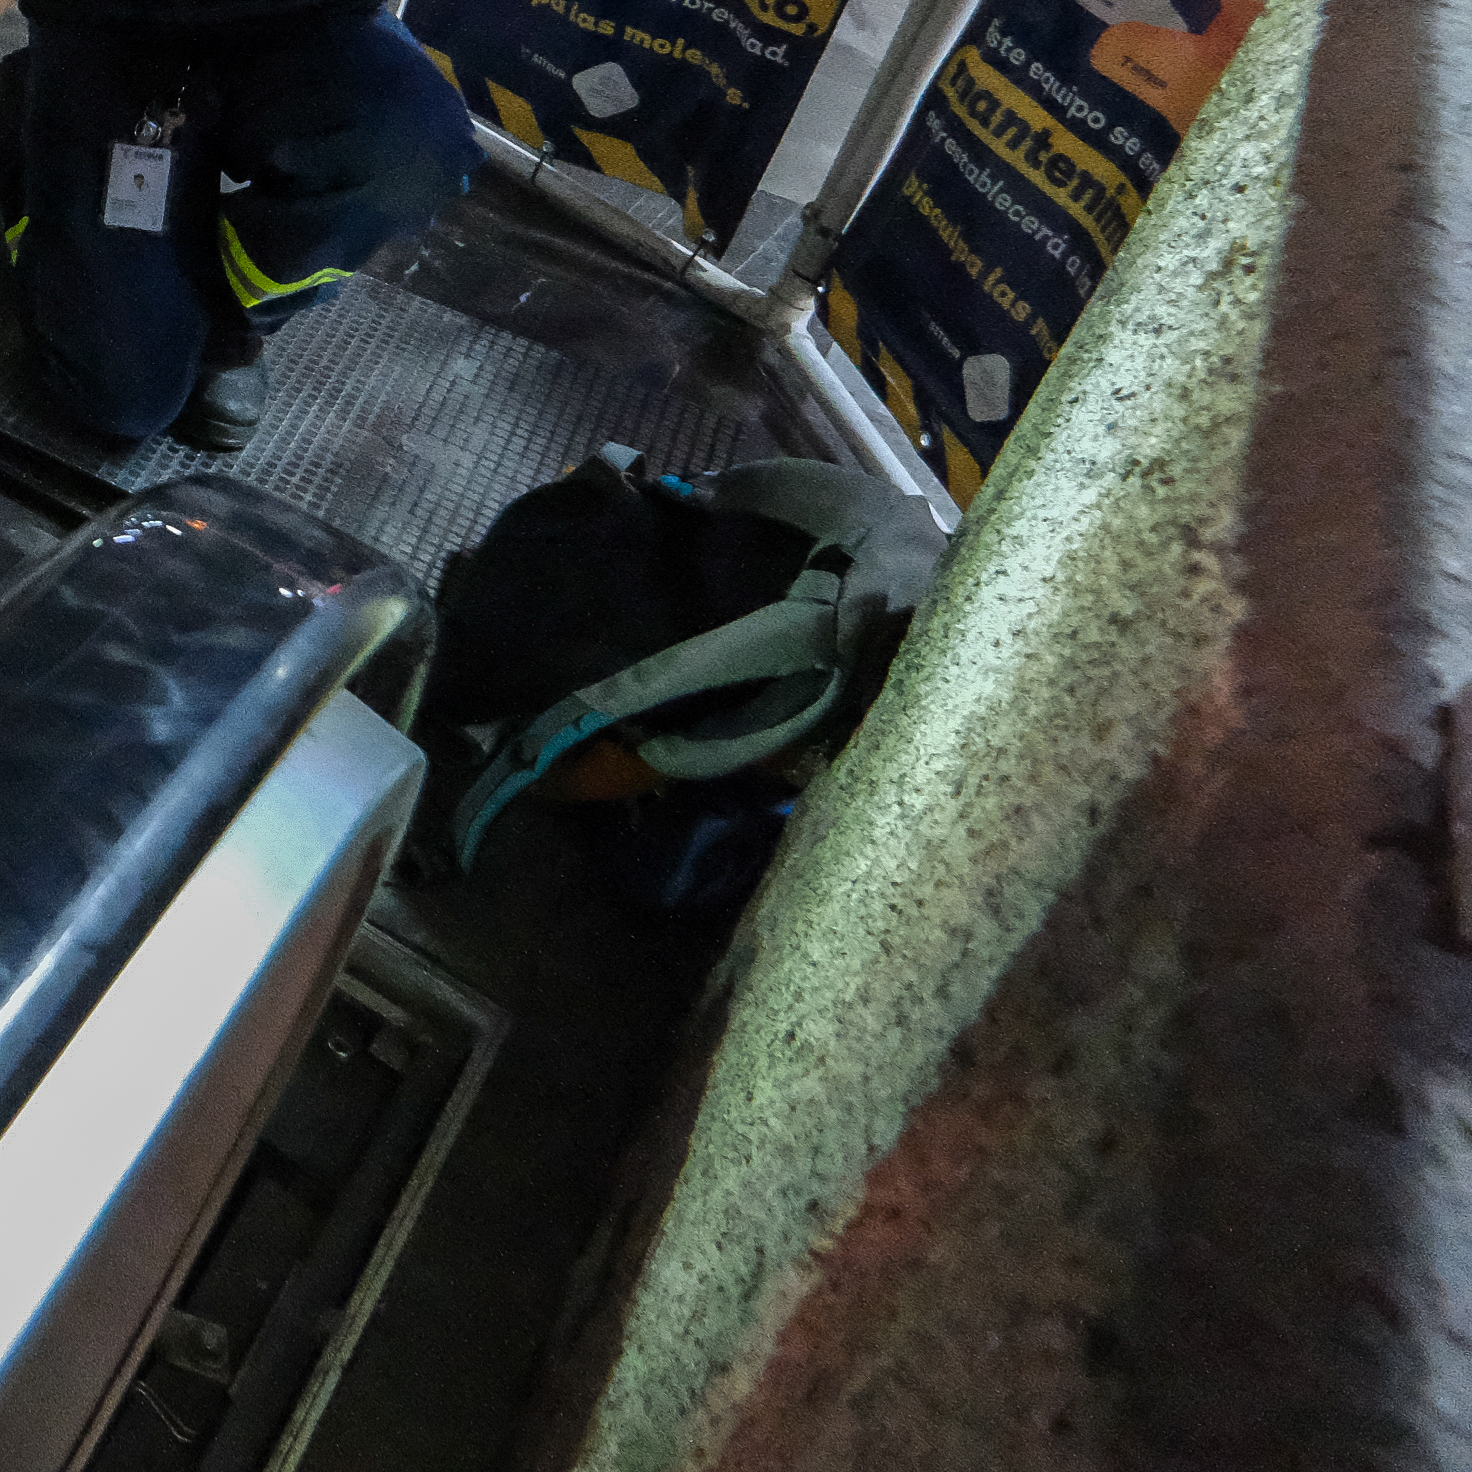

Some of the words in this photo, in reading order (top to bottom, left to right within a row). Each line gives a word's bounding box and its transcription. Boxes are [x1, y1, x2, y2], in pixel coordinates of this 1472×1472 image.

[569, 1, 616, 36] las
[1029, 60, 1106, 130] equipo
[1109, 126, 1141, 156] se
[983, 267, 1033, 322] las
